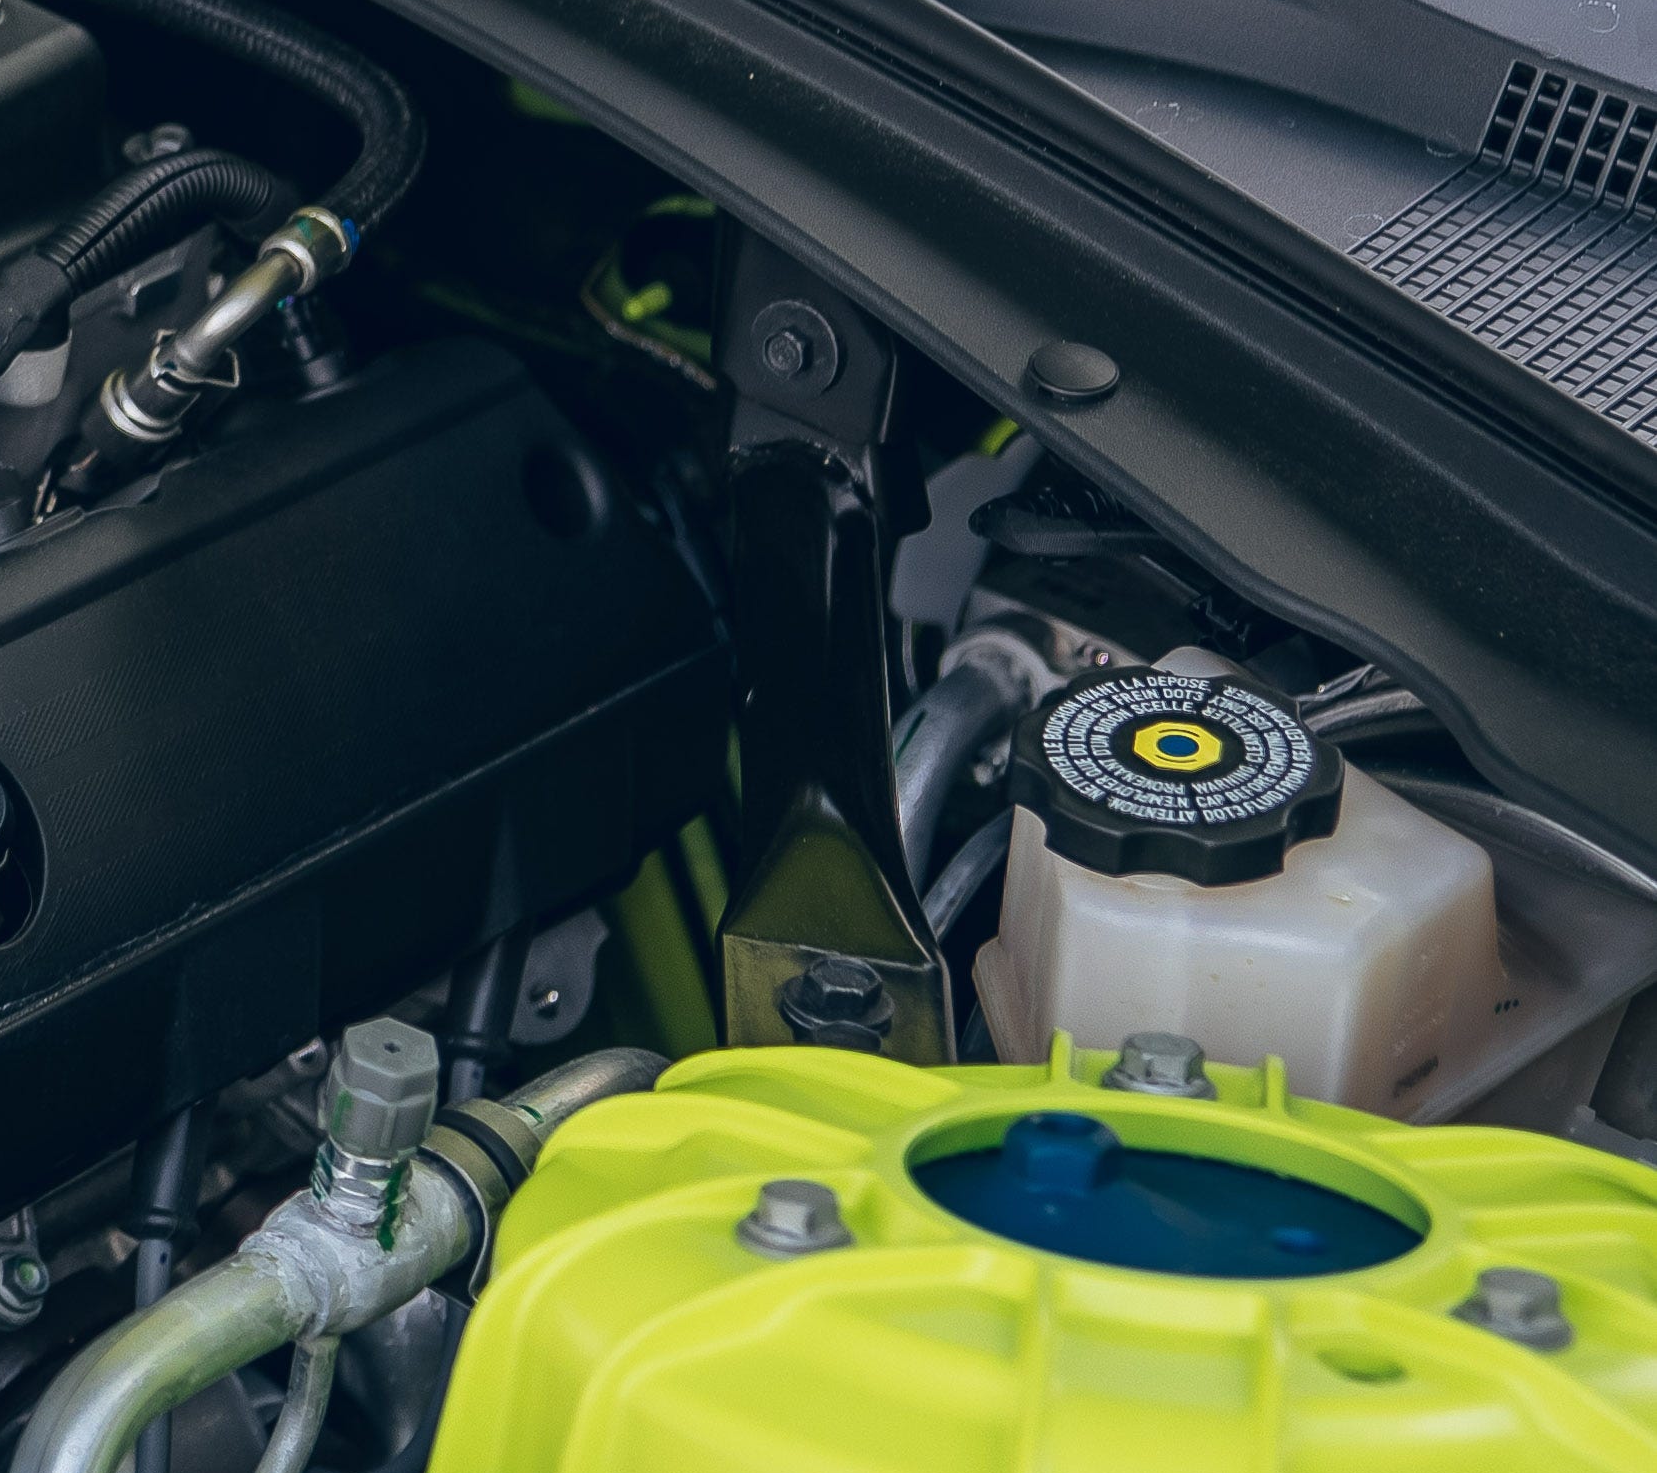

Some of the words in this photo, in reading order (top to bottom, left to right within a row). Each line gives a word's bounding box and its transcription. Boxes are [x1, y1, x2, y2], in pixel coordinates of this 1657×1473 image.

[1120, 677, 1145, 689] LA
[1075, 681, 1120, 705] AVANT
[1111, 688, 1160, 705] FREIN
[1163, 688, 1204, 702] DOT3
[1091, 699, 1116, 713] DE
[1208, 695, 1249, 714] ONLY
[1042, 700, 1083, 740] BOUCHON
[1067, 708, 1102, 742] LIQUIDE
[1093, 708, 1134, 734] BIDON
[1202, 706, 1253, 734] FILLER
[1243, 710, 1274, 730] USE
[1043, 742, 1065, 754] LE
[1068, 744, 1089, 756] DU
[1241, 732, 1265, 763] CLEAN
[1285, 728, 1313, 762] SEALED
[1074, 758, 1102, 777] QUE
[1292, 763, 1312, 771] A
[1225, 773, 1277, 802] BEFORE
[1275, 768, 1309, 796] FROM
[1195, 794, 1226, 807] CAP
[1243, 790, 1286, 815] FLUID
[1203, 805, 1247, 823] DOT3
